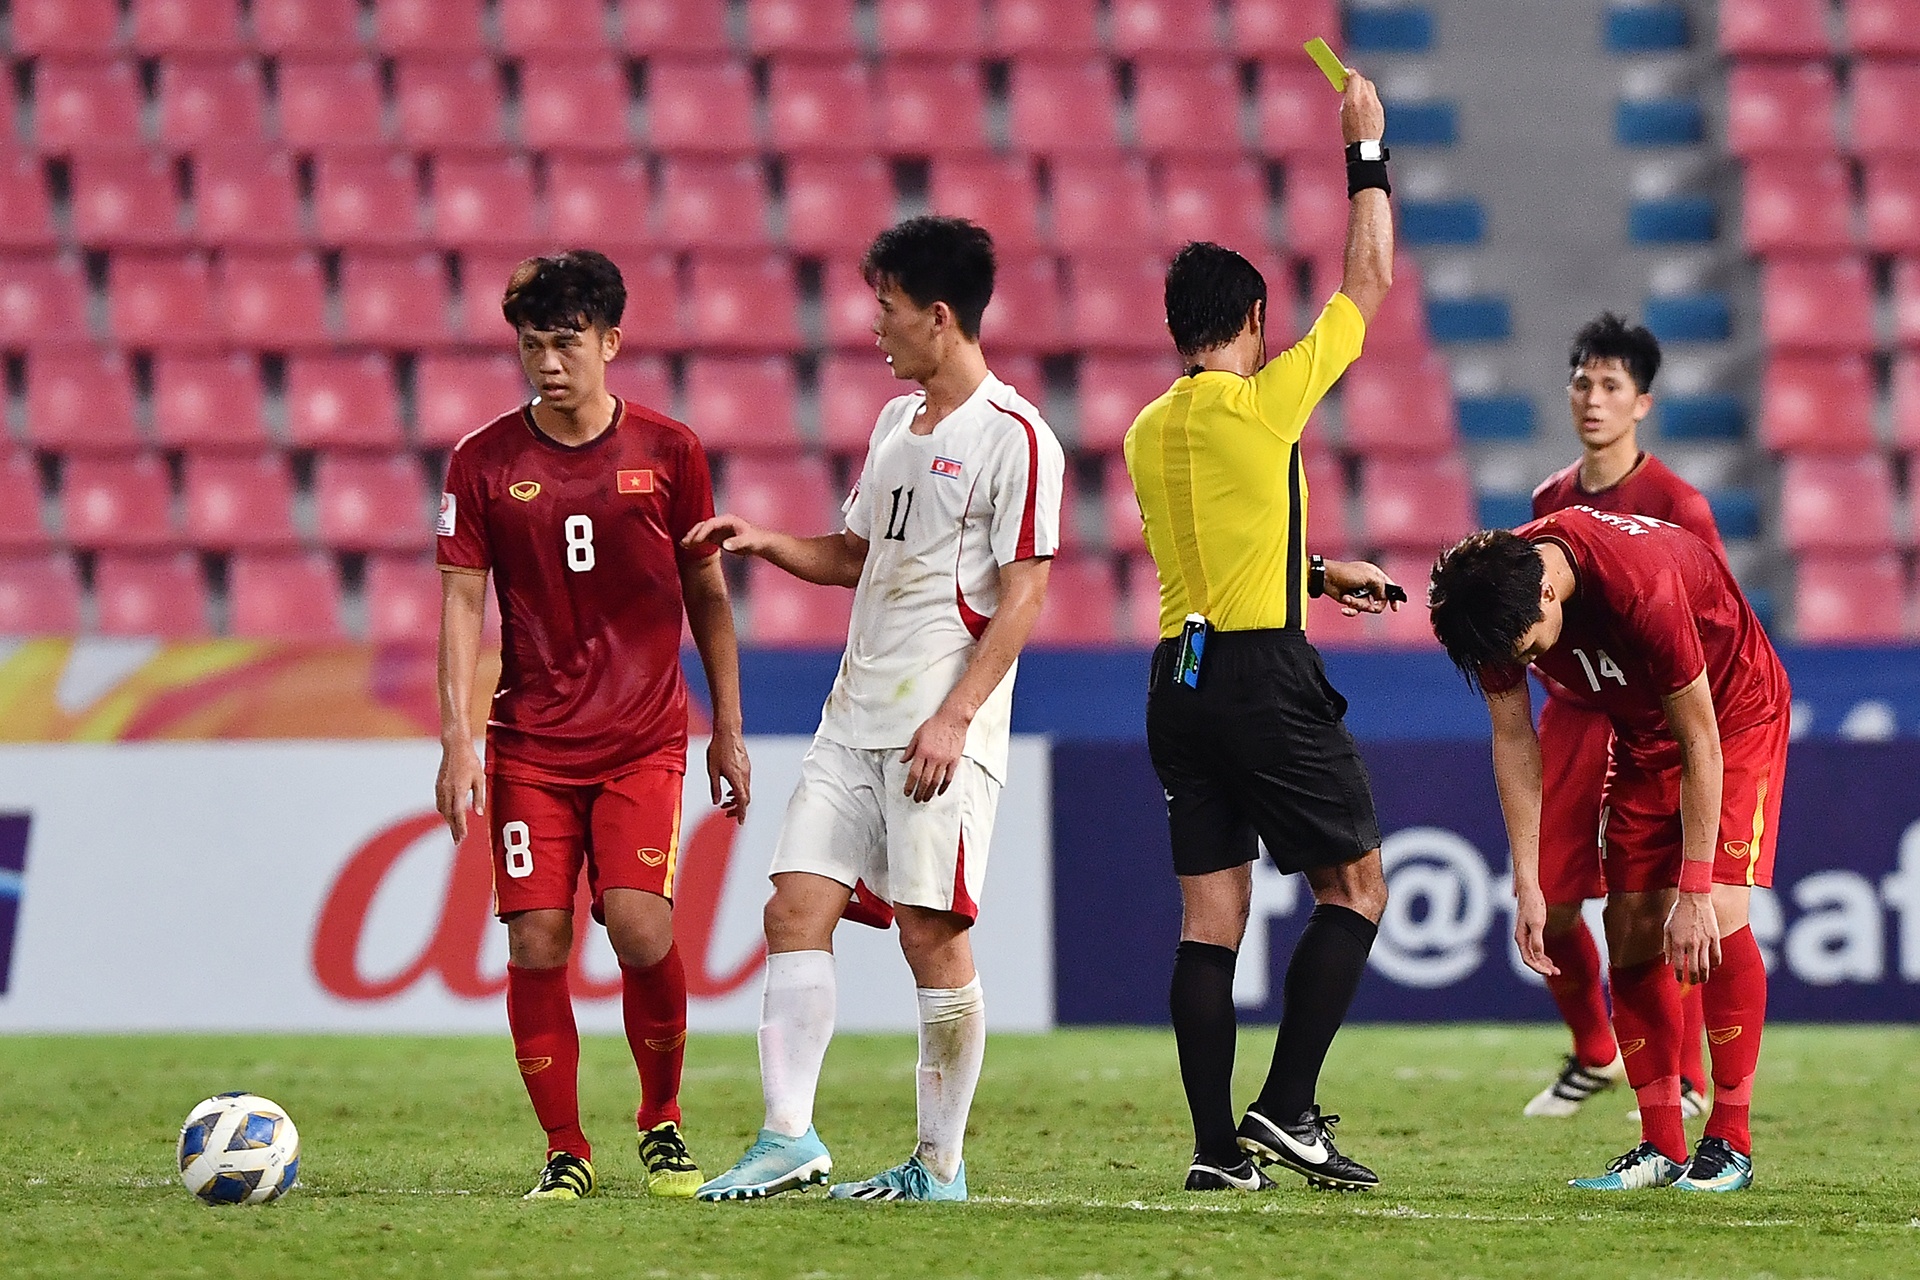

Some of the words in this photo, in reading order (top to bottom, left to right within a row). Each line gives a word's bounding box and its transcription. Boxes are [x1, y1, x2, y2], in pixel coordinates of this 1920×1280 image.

[884, 485, 914, 541] 11
[564, 514, 596, 572] 8
[1572, 648, 1628, 692] 14
[502, 820, 534, 878] 8
